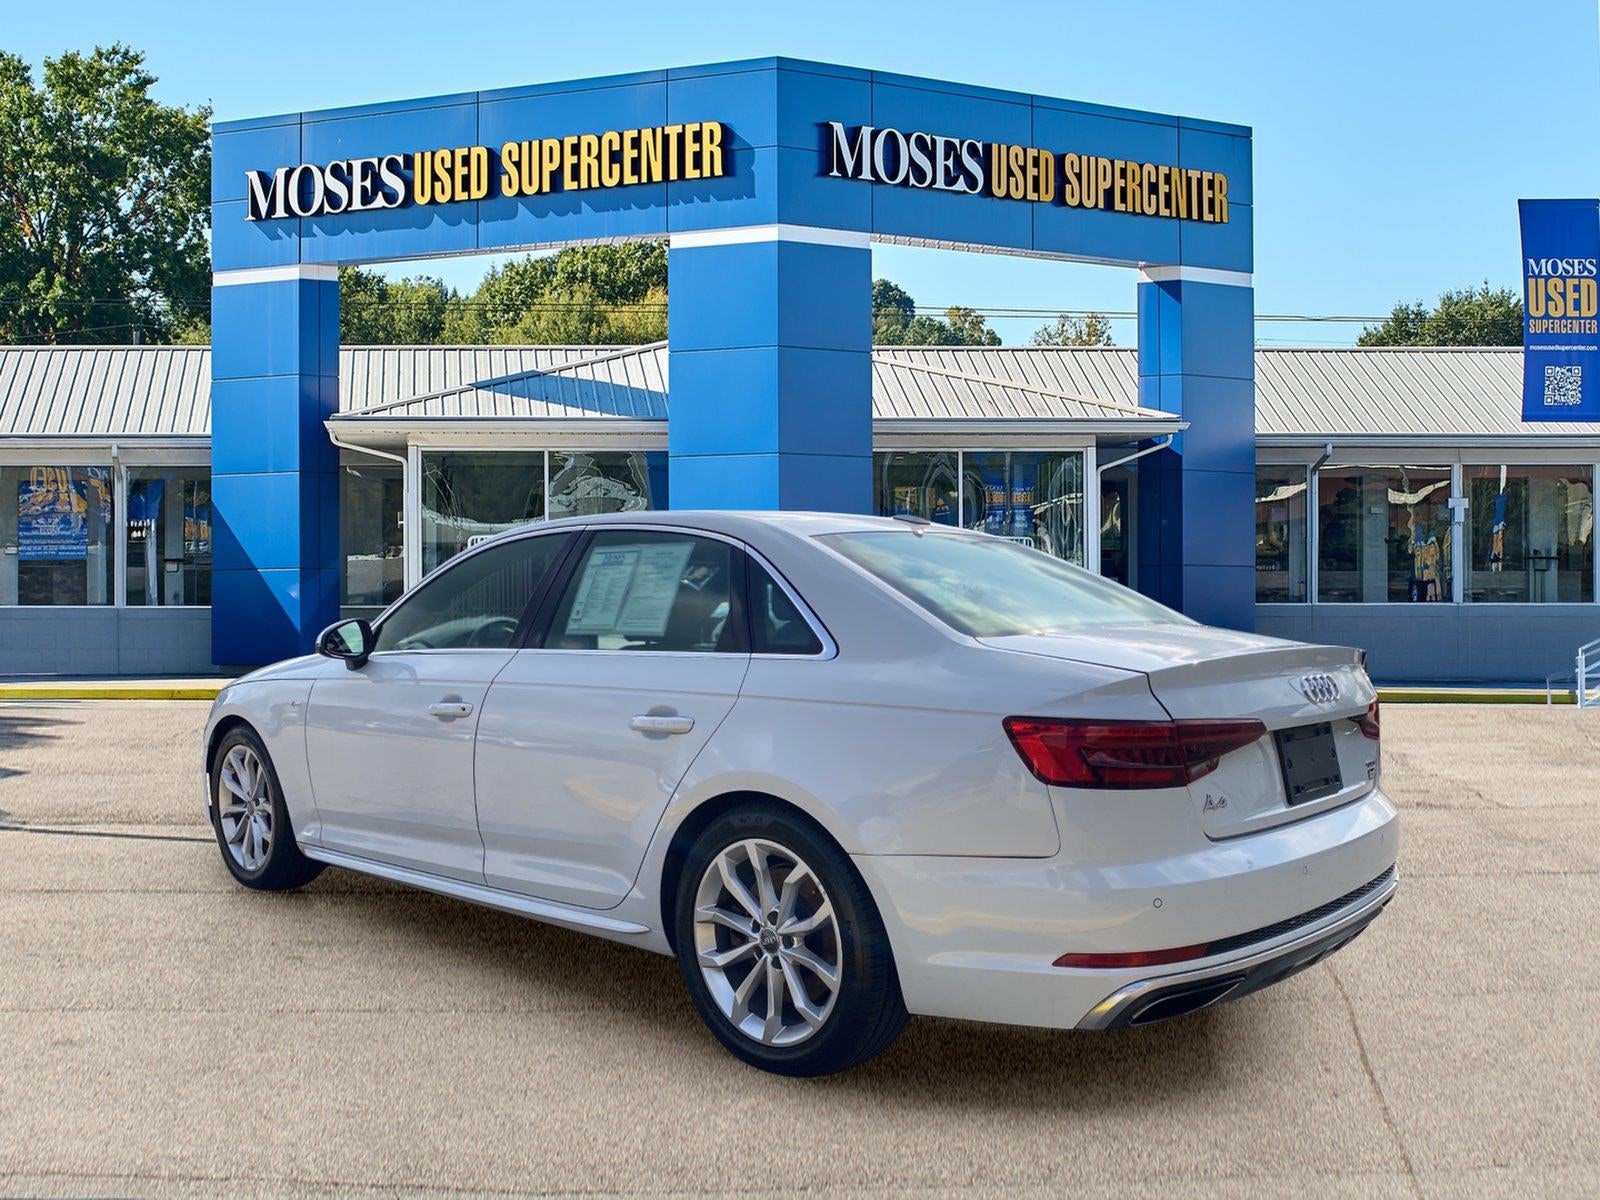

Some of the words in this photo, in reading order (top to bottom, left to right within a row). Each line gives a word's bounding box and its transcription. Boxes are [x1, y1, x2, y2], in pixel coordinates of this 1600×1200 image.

[244, 154, 407, 222] MOSES
[413, 144, 489, 206] USED
[500, 120, 724, 198] SUPERCENTER
[828, 120, 985, 195] MOSES
[991, 142, 1056, 202] USED
[1064, 152, 1230, 224] SUPERCENTER
[1527, 258, 1597, 277] MOSES
[1528, 277, 1598, 318] USED
[1529, 319, 1598, 334] SUPERCENTER
